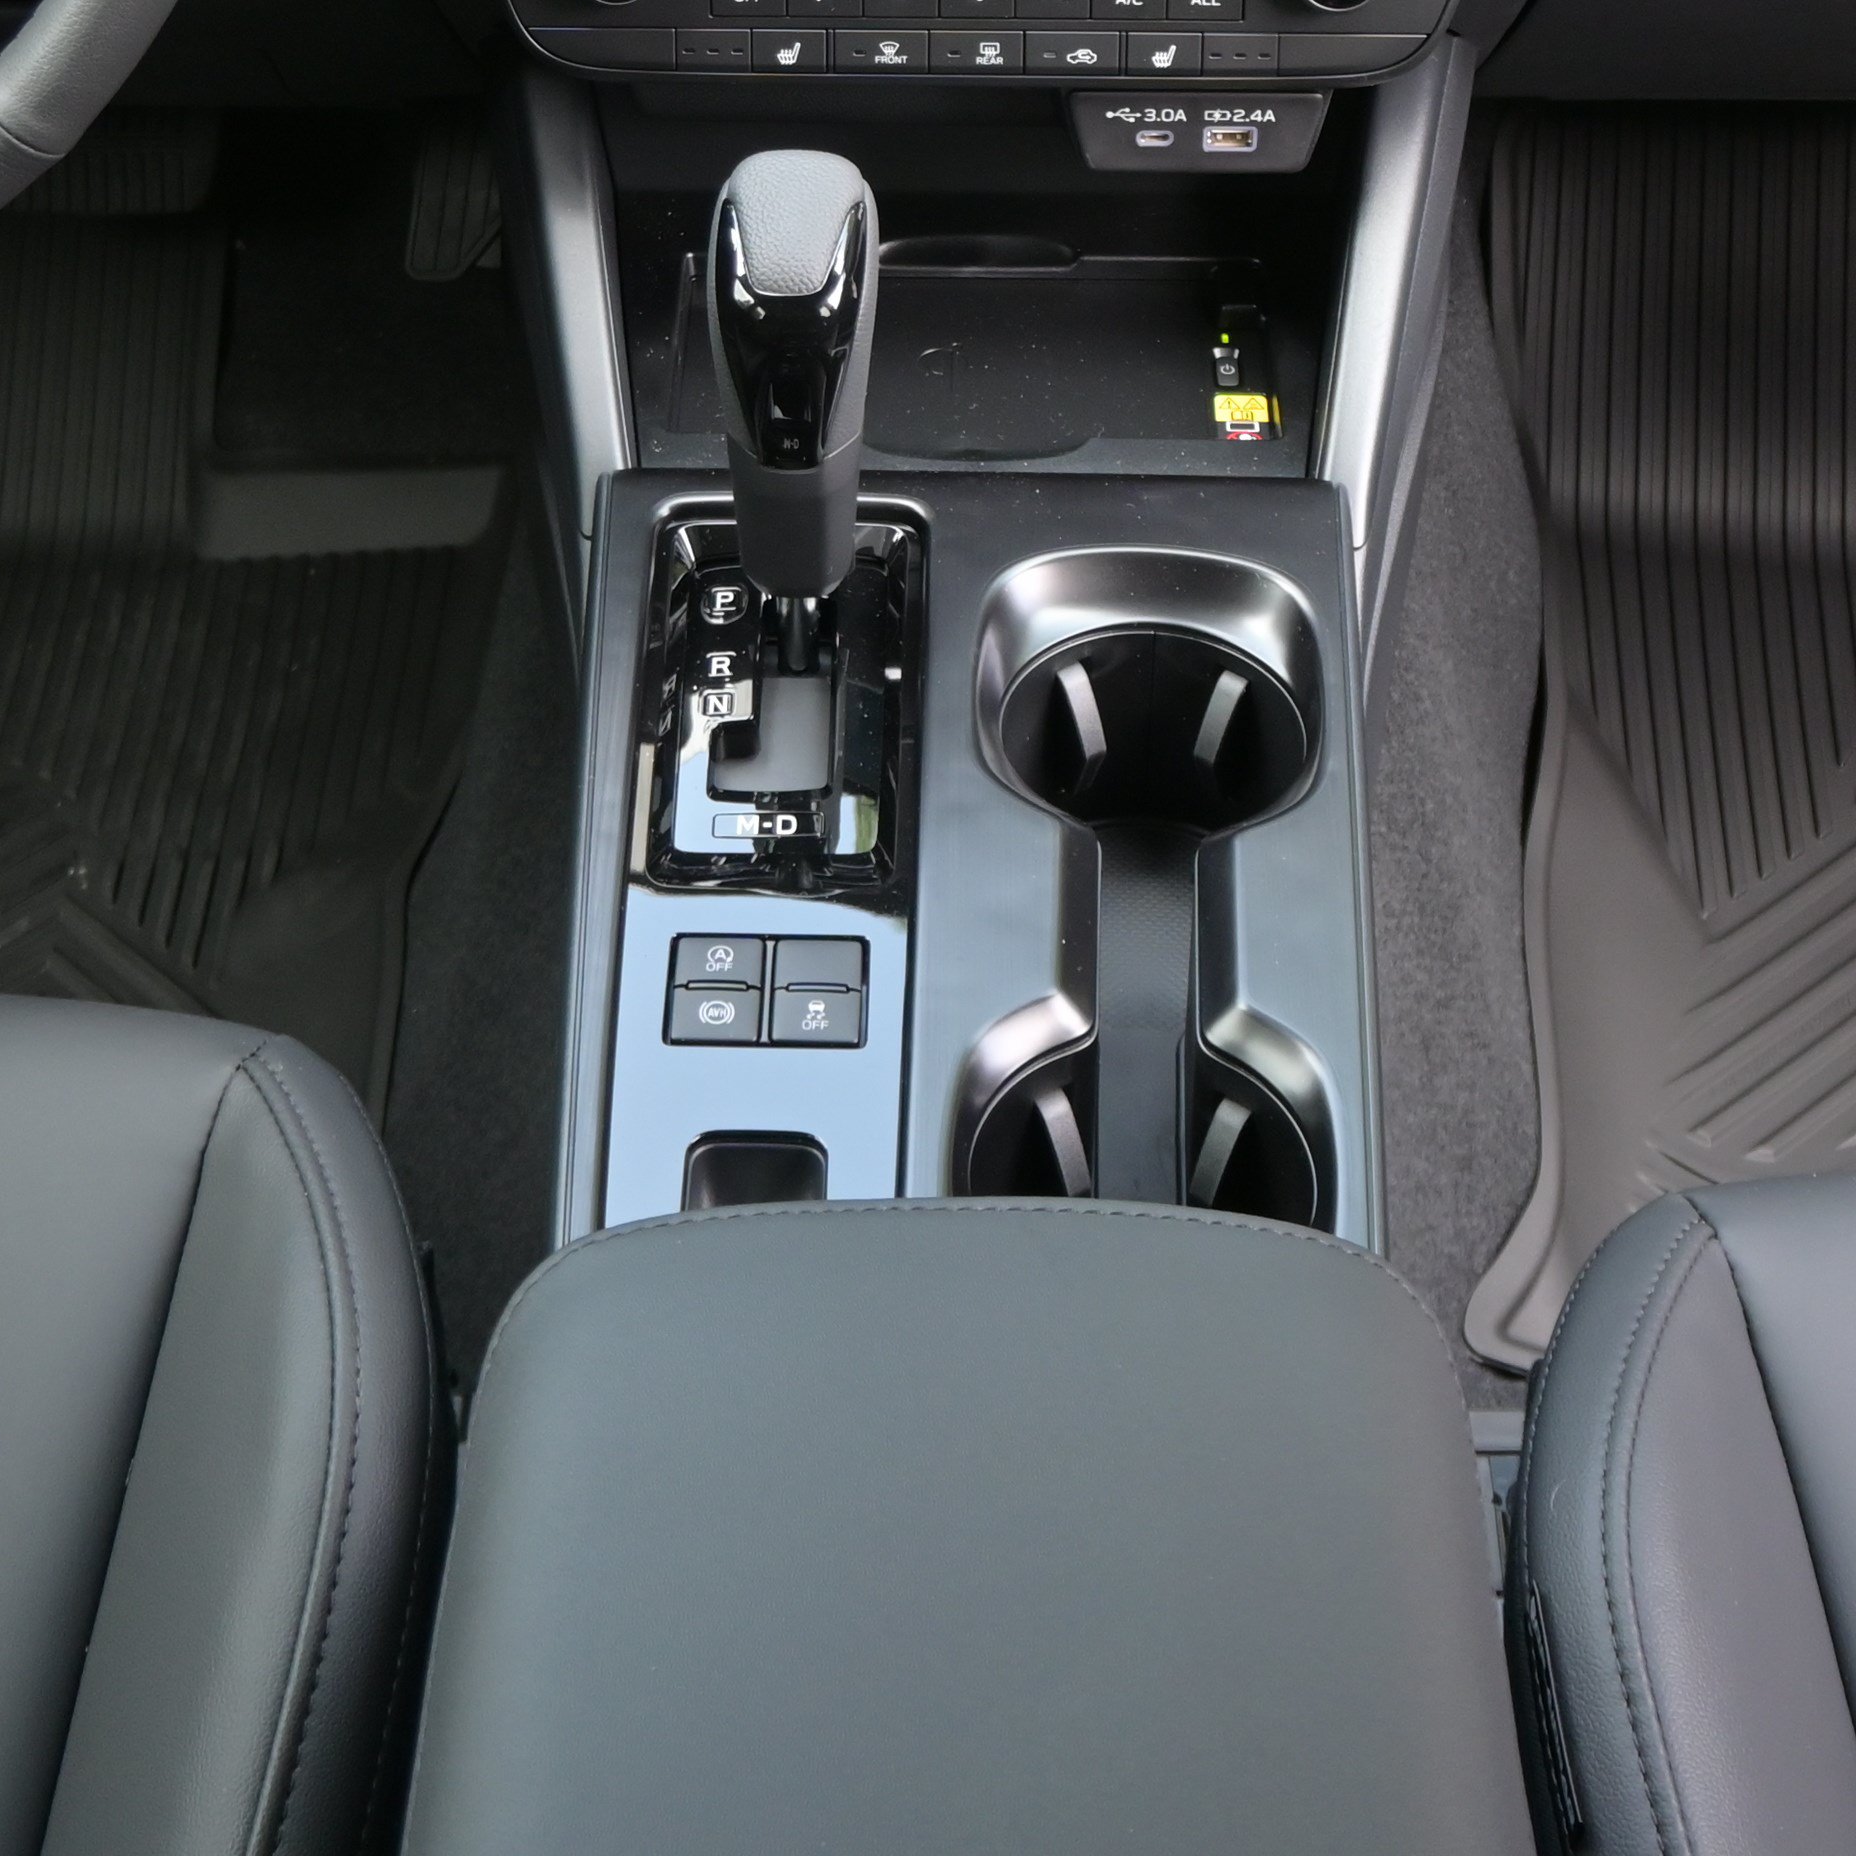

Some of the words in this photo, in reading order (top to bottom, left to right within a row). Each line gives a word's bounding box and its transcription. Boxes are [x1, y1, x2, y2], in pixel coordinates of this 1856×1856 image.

[874, 55, 908, 65] FRONT
[976, 55, 1004, 65] REAR
[1143, 108, 1187, 123] 3.0A
[1233, 109, 1276, 124] 2.4A
[715, 591, 735, 610] P
[711, 656, 731, 676] R
[708, 695, 729, 715] N
[736, 814, 798, 835] M-D
[705, 962, 733, 972] OFF
[707, 1007, 728, 1018] AVH
[801, 1020, 829, 1031] OFF
